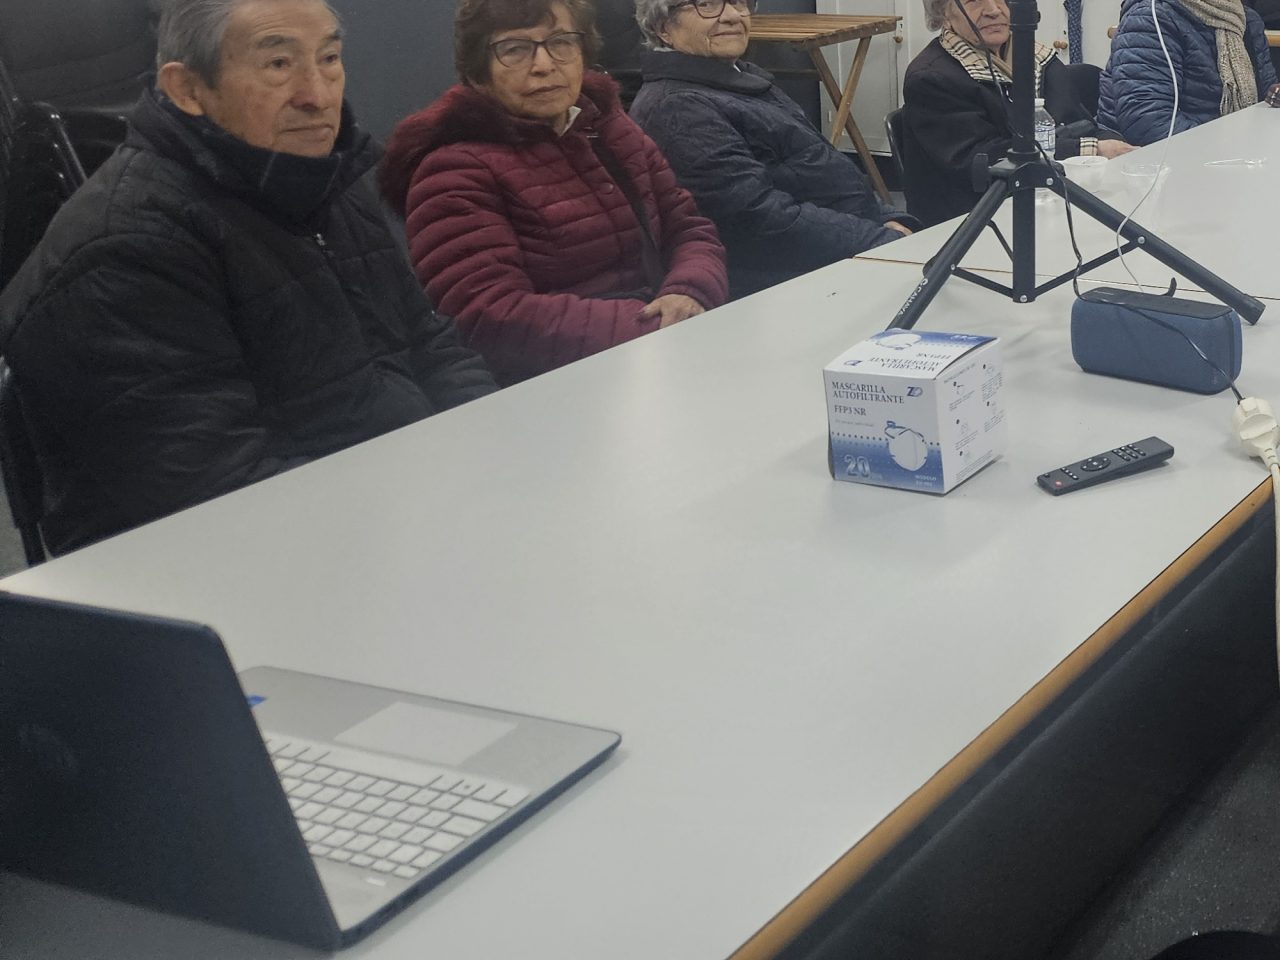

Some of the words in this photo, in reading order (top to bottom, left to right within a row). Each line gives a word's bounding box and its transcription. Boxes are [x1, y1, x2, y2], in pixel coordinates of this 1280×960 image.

[832, 381, 886, 394] MASCARILLA
[833, 390, 905, 404] AUTOFILTRANTE
[834, 404, 852, 415] FFP3
[854, 407, 867, 417] NR
